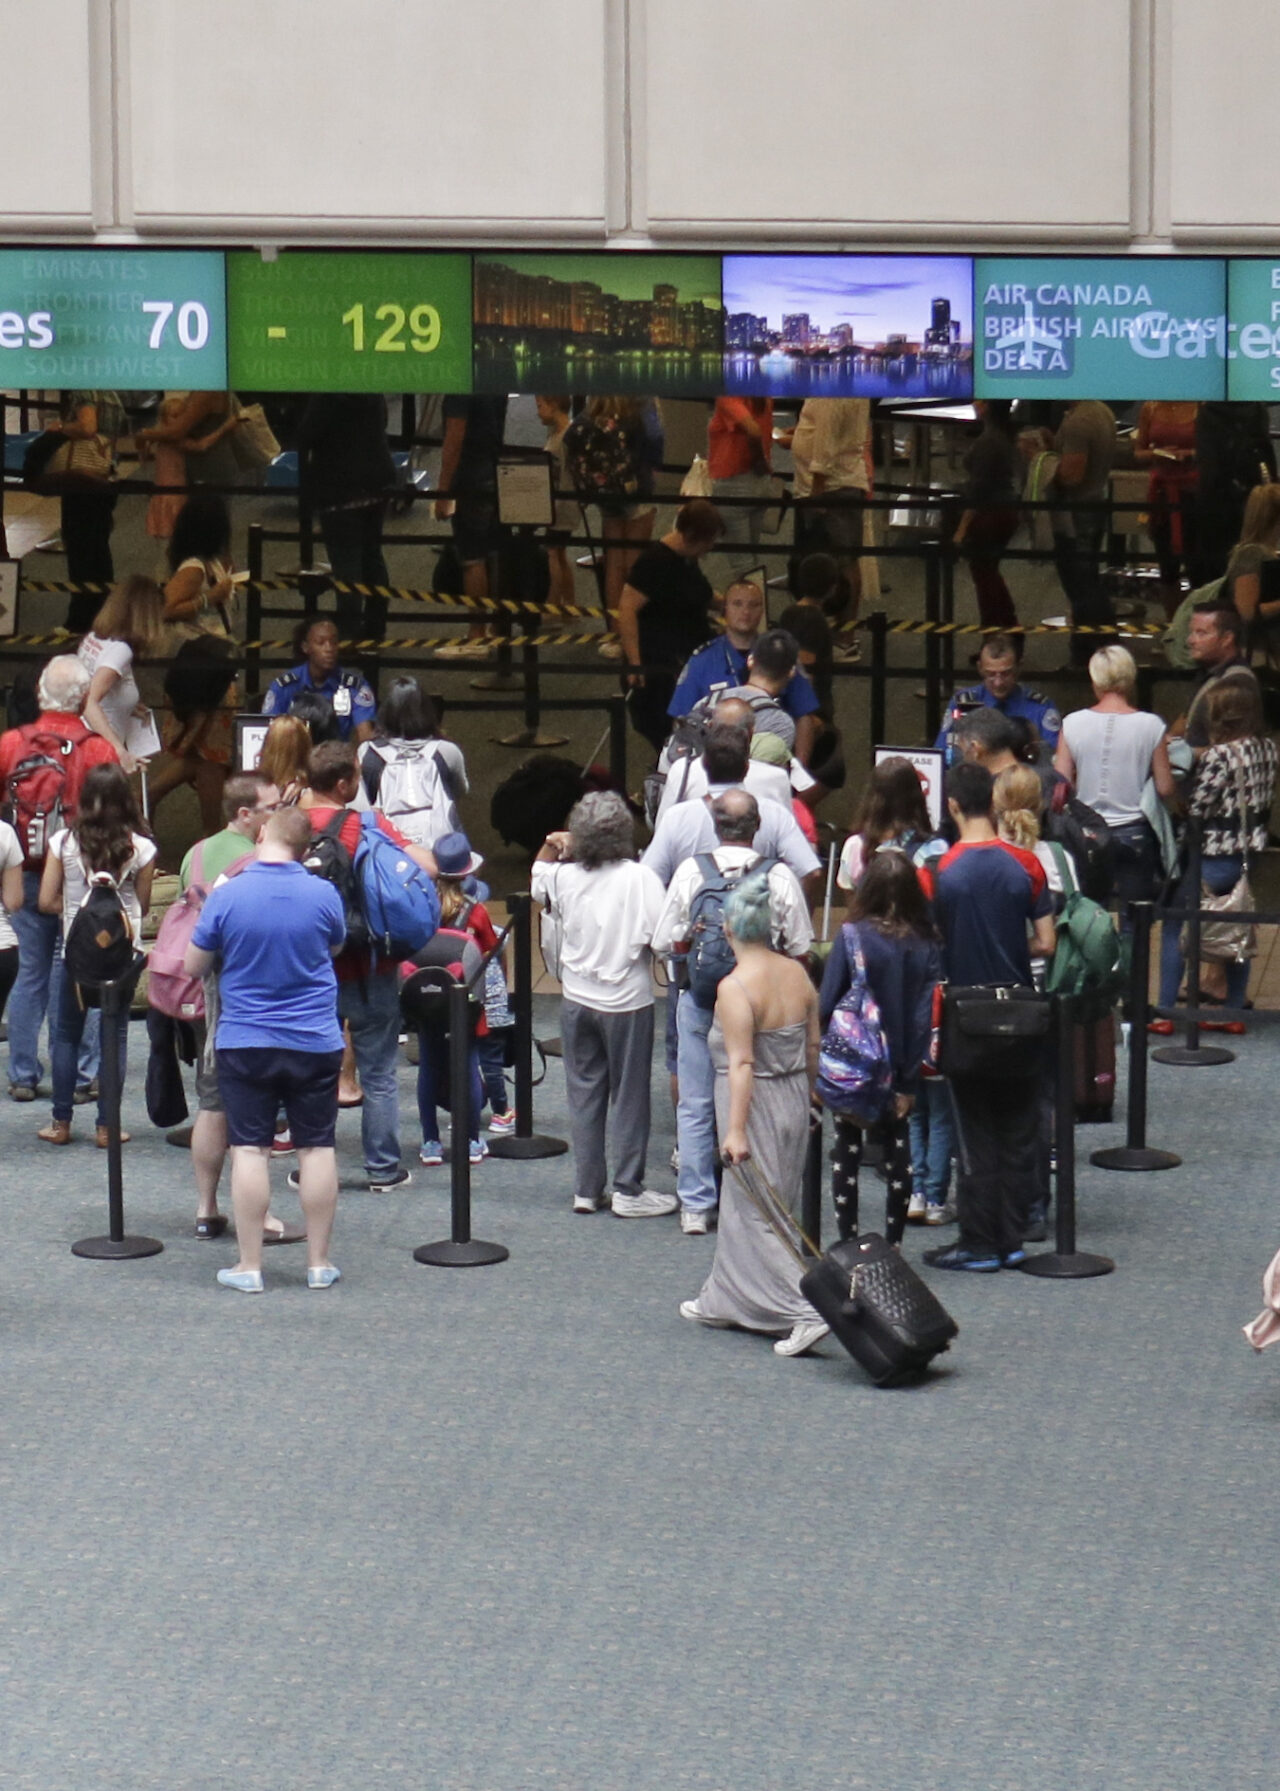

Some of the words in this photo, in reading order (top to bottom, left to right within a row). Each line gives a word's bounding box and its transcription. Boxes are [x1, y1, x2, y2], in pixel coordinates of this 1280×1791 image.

[984, 284, 1028, 305] AIR
[1035, 284, 1153, 306] CANADA
[142, 301, 209, 350] 70
[342, 303, 441, 352] 129
[985, 317, 1081, 339] BRITISH
[1091, 318, 1218, 341] AIRWAYS
[985, 350, 1068, 371] DELTA
